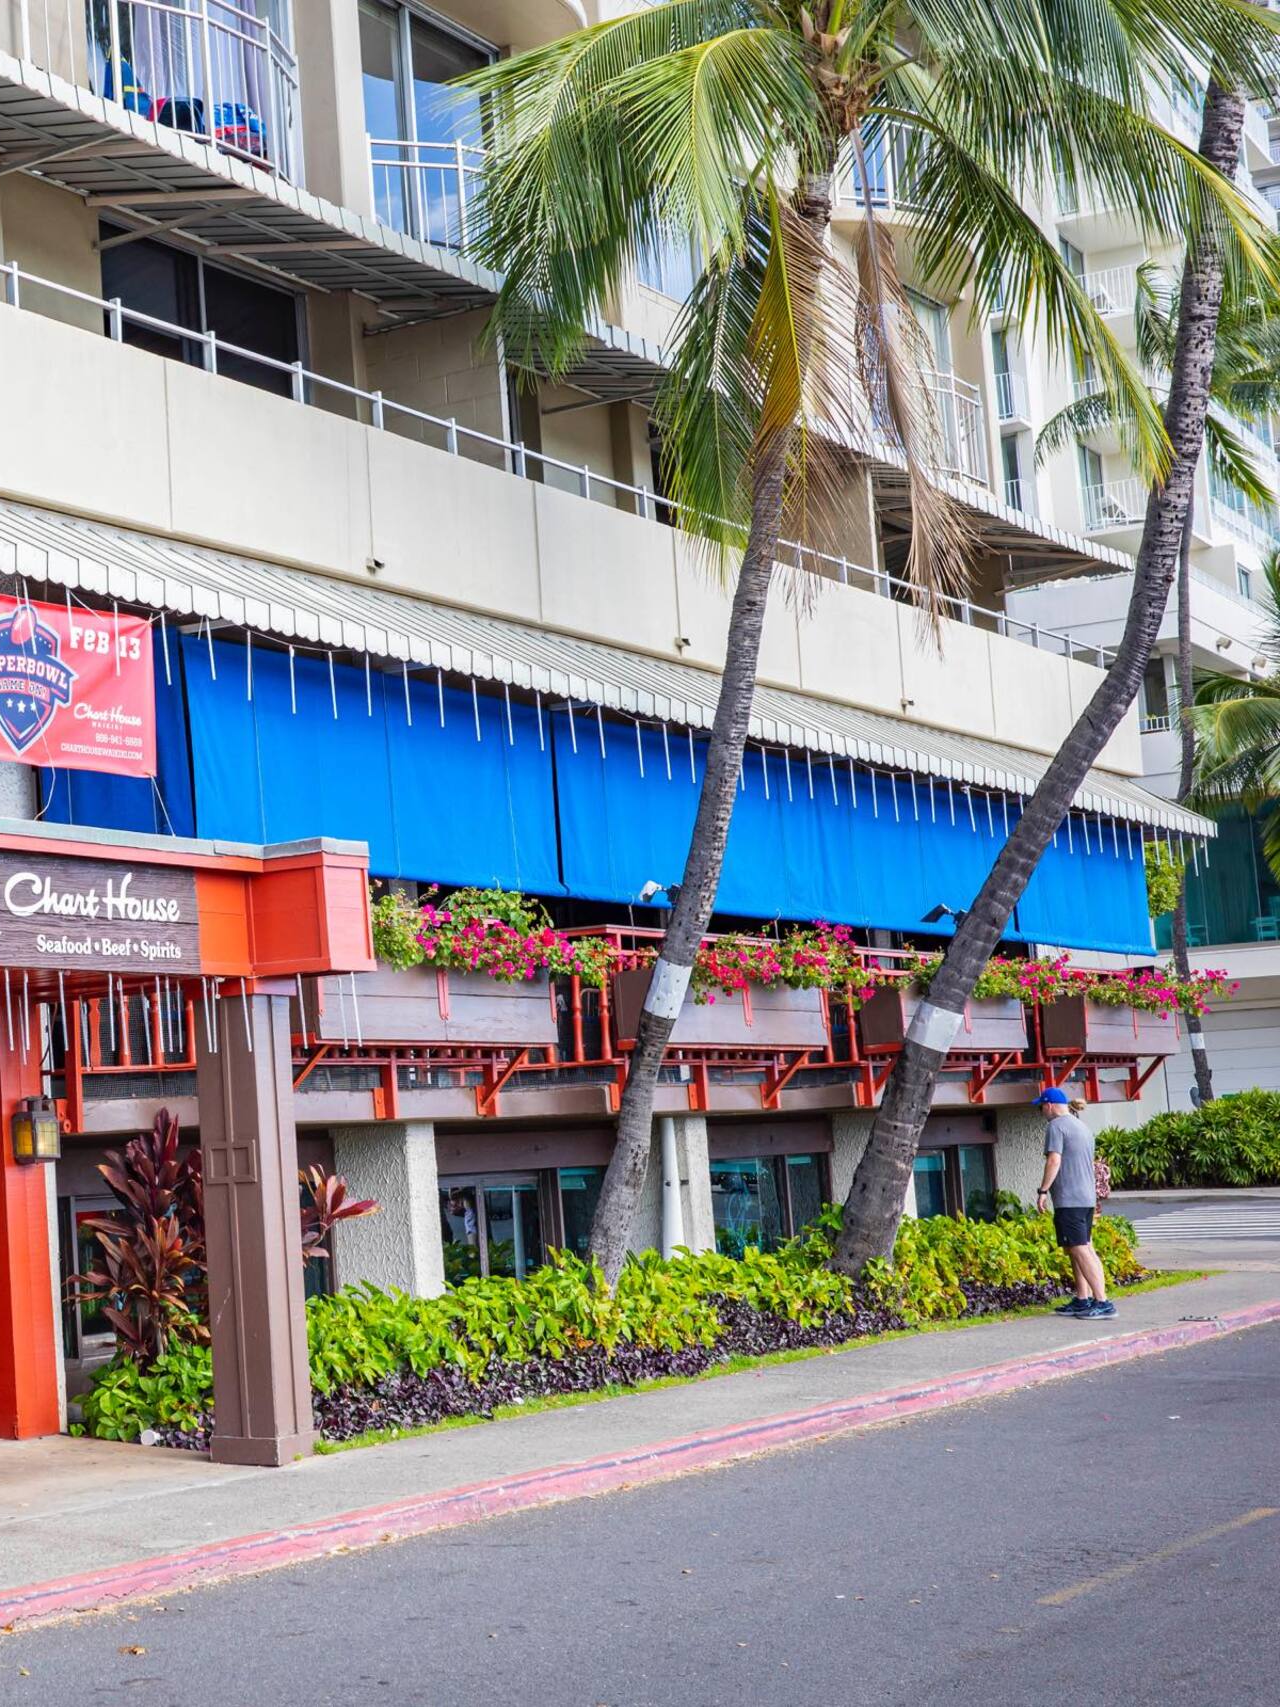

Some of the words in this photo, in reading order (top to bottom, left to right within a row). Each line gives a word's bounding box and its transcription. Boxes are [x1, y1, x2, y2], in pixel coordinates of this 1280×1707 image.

[119, 636, 141, 660] 13
[73, 702, 108, 720] Chart
[108, 705, 142, 726] House
[4, 872, 100, 918] Chart
[102, 872, 180, 922] House
[36, 935, 92, 956] Seafood
[101, 938, 131, 957] Beef
[140, 941, 182, 961] Spirits
